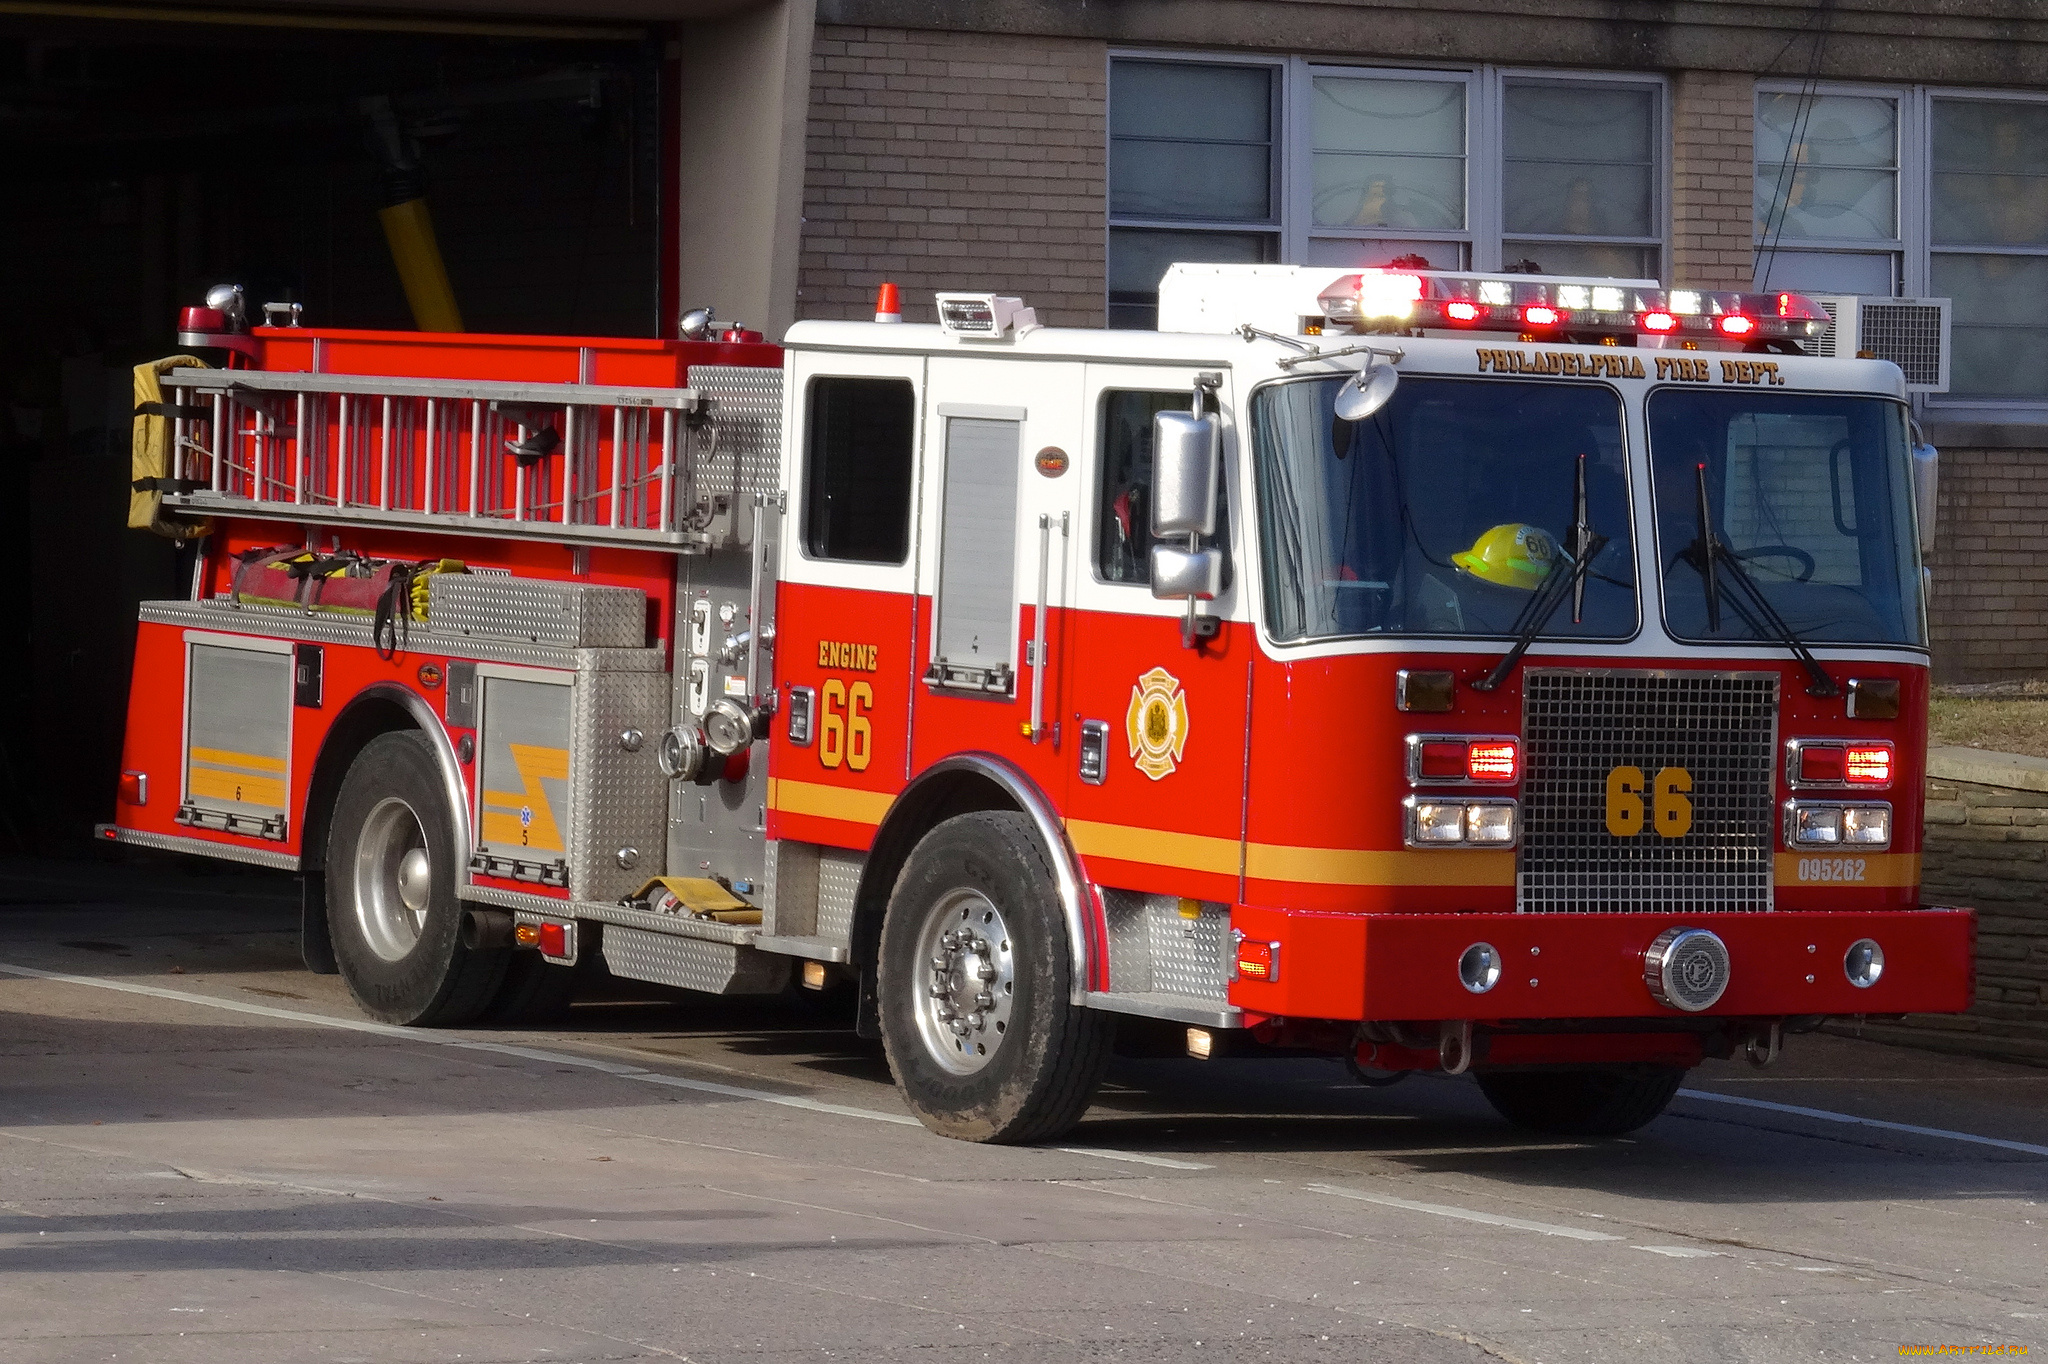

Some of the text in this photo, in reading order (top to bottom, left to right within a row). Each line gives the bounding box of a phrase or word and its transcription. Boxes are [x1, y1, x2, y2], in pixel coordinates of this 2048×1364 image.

[1476, 348, 1785, 385] PHILADELPHIA FIRE DEPT.
[818, 640, 878, 672] ENGINE
[819, 678, 873, 772] 66
[235, 785, 242, 801] 6
[1605, 765, 1693, 838] 66
[522, 829, 528, 846] 5
[1798, 858, 1866, 881] 095262
